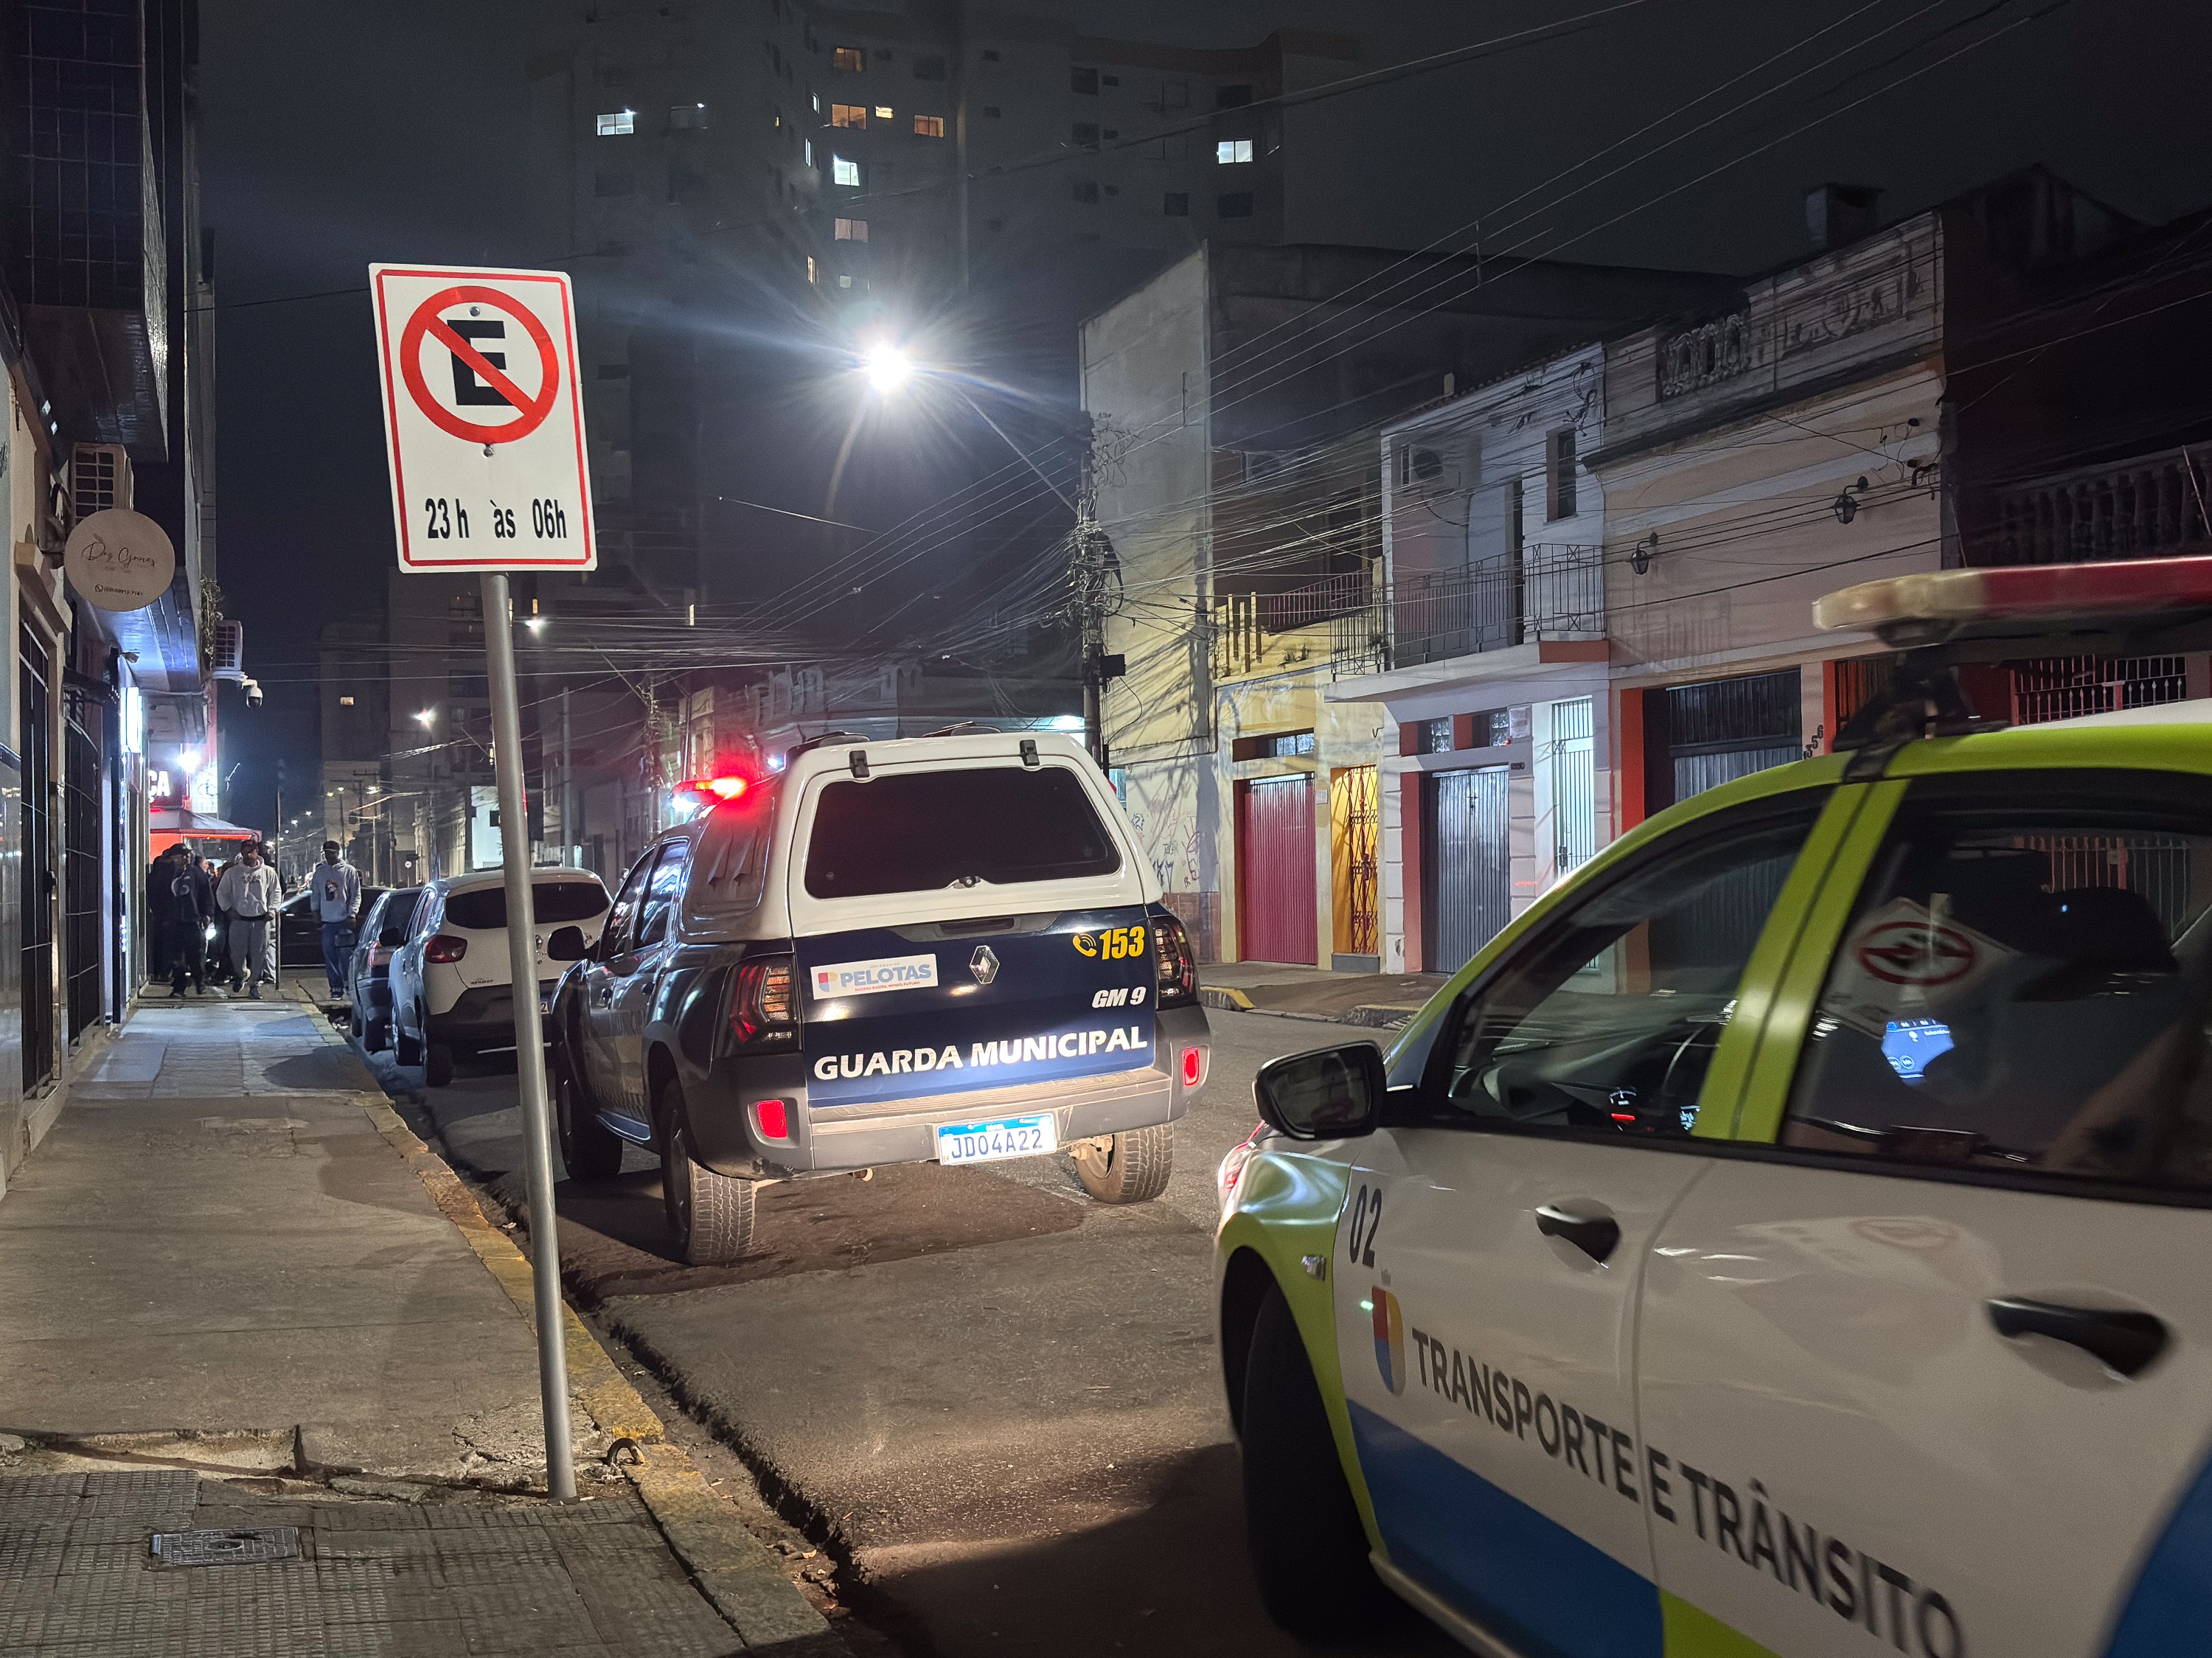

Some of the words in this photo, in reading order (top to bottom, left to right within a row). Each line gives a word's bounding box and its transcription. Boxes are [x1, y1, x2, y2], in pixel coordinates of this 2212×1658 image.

[446, 320, 515, 406] E
[490, 499, 516, 538] às
[532, 498, 567, 539] 06h
[1099, 926, 1145, 960] 153
[841, 964, 932, 988] PELOTAS
[1092, 988, 1129, 1008] GM
[1130, 986, 1147, 1005] 9
[813, 1045, 964, 1081] GUARDA
[970, 1025, 1148, 1068] MUNICIPAL
[1349, 1184, 1382, 1269] 02
[1412, 1326, 1639, 1504] TRANSPORTE
[1644, 1443, 1677, 1525] E
[1677, 1459, 1966, 1658] TRÂNSITO
